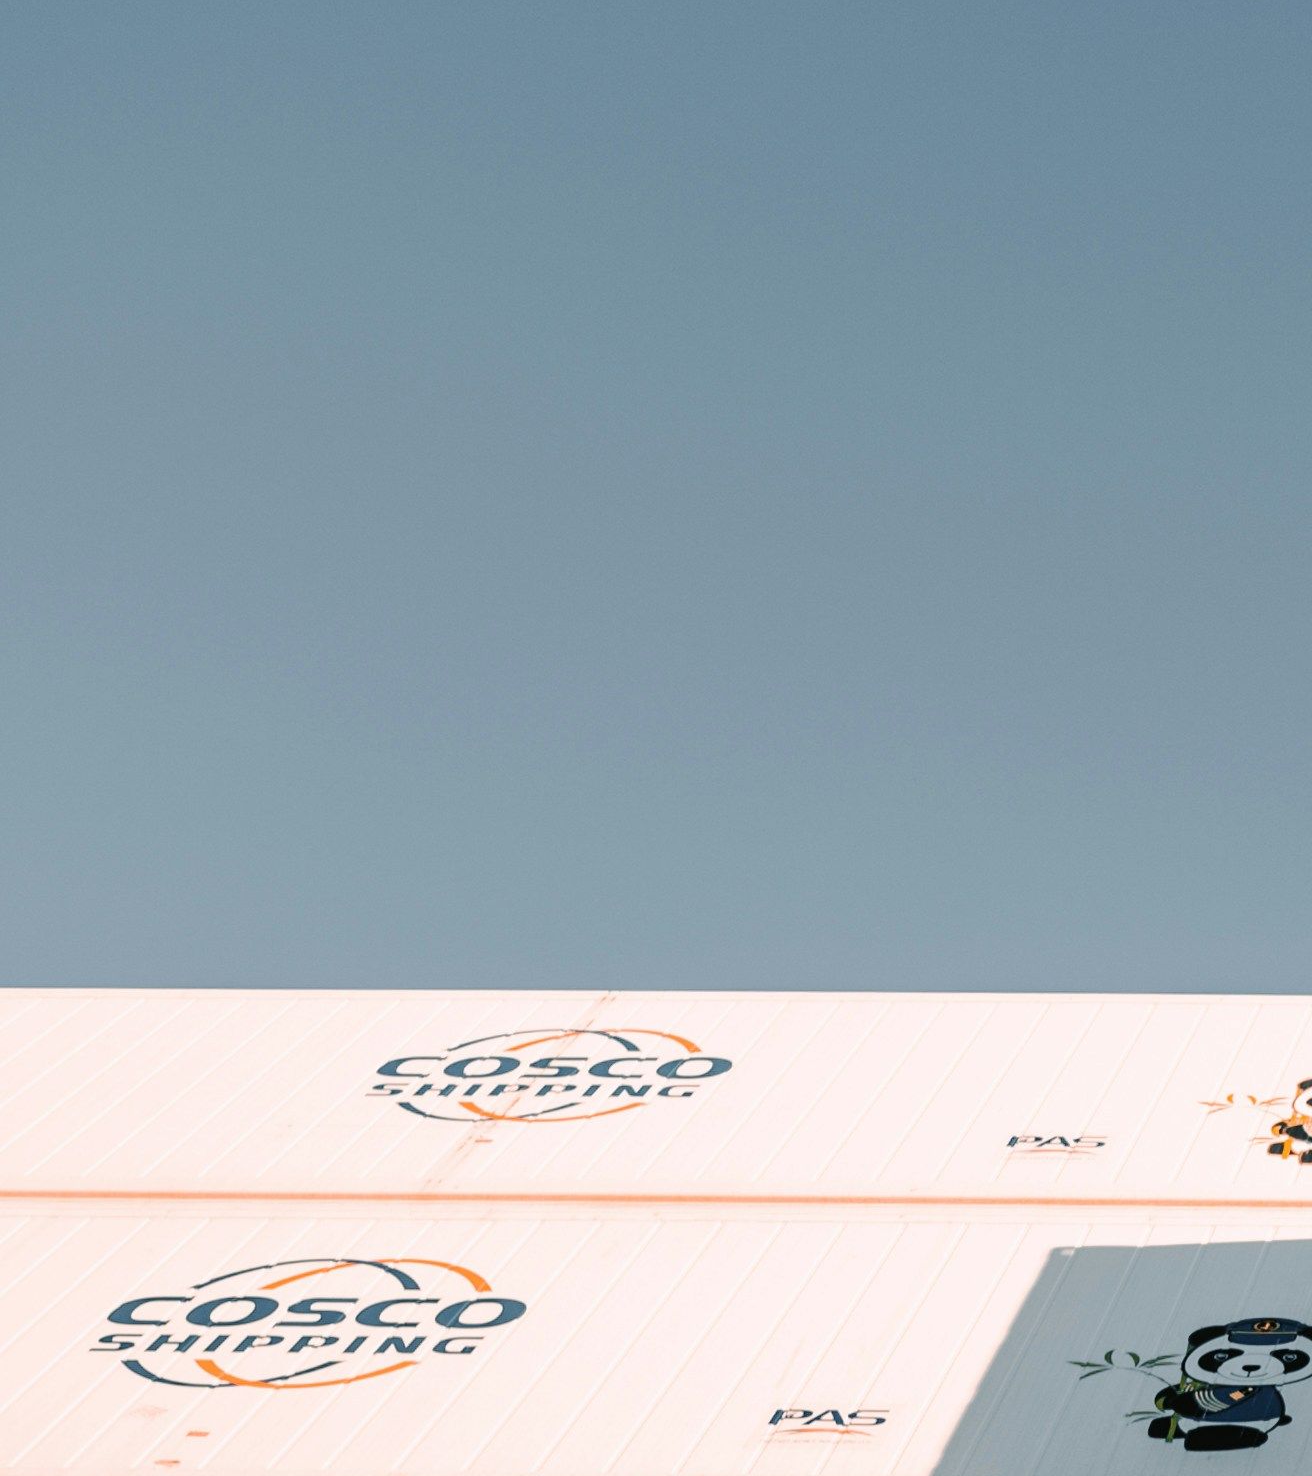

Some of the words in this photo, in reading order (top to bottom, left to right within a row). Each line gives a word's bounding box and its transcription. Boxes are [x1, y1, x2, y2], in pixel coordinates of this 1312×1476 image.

[376, 1056, 733, 1079] COSCO
[364, 1083, 703, 1098] SHIPPING
[1006, 1136, 1107, 1148] PAS
[105, 1297, 527, 1329] COSCO
[90, 1335, 486, 1355] SHIPPING
[769, 1409, 889, 1426] PAS
